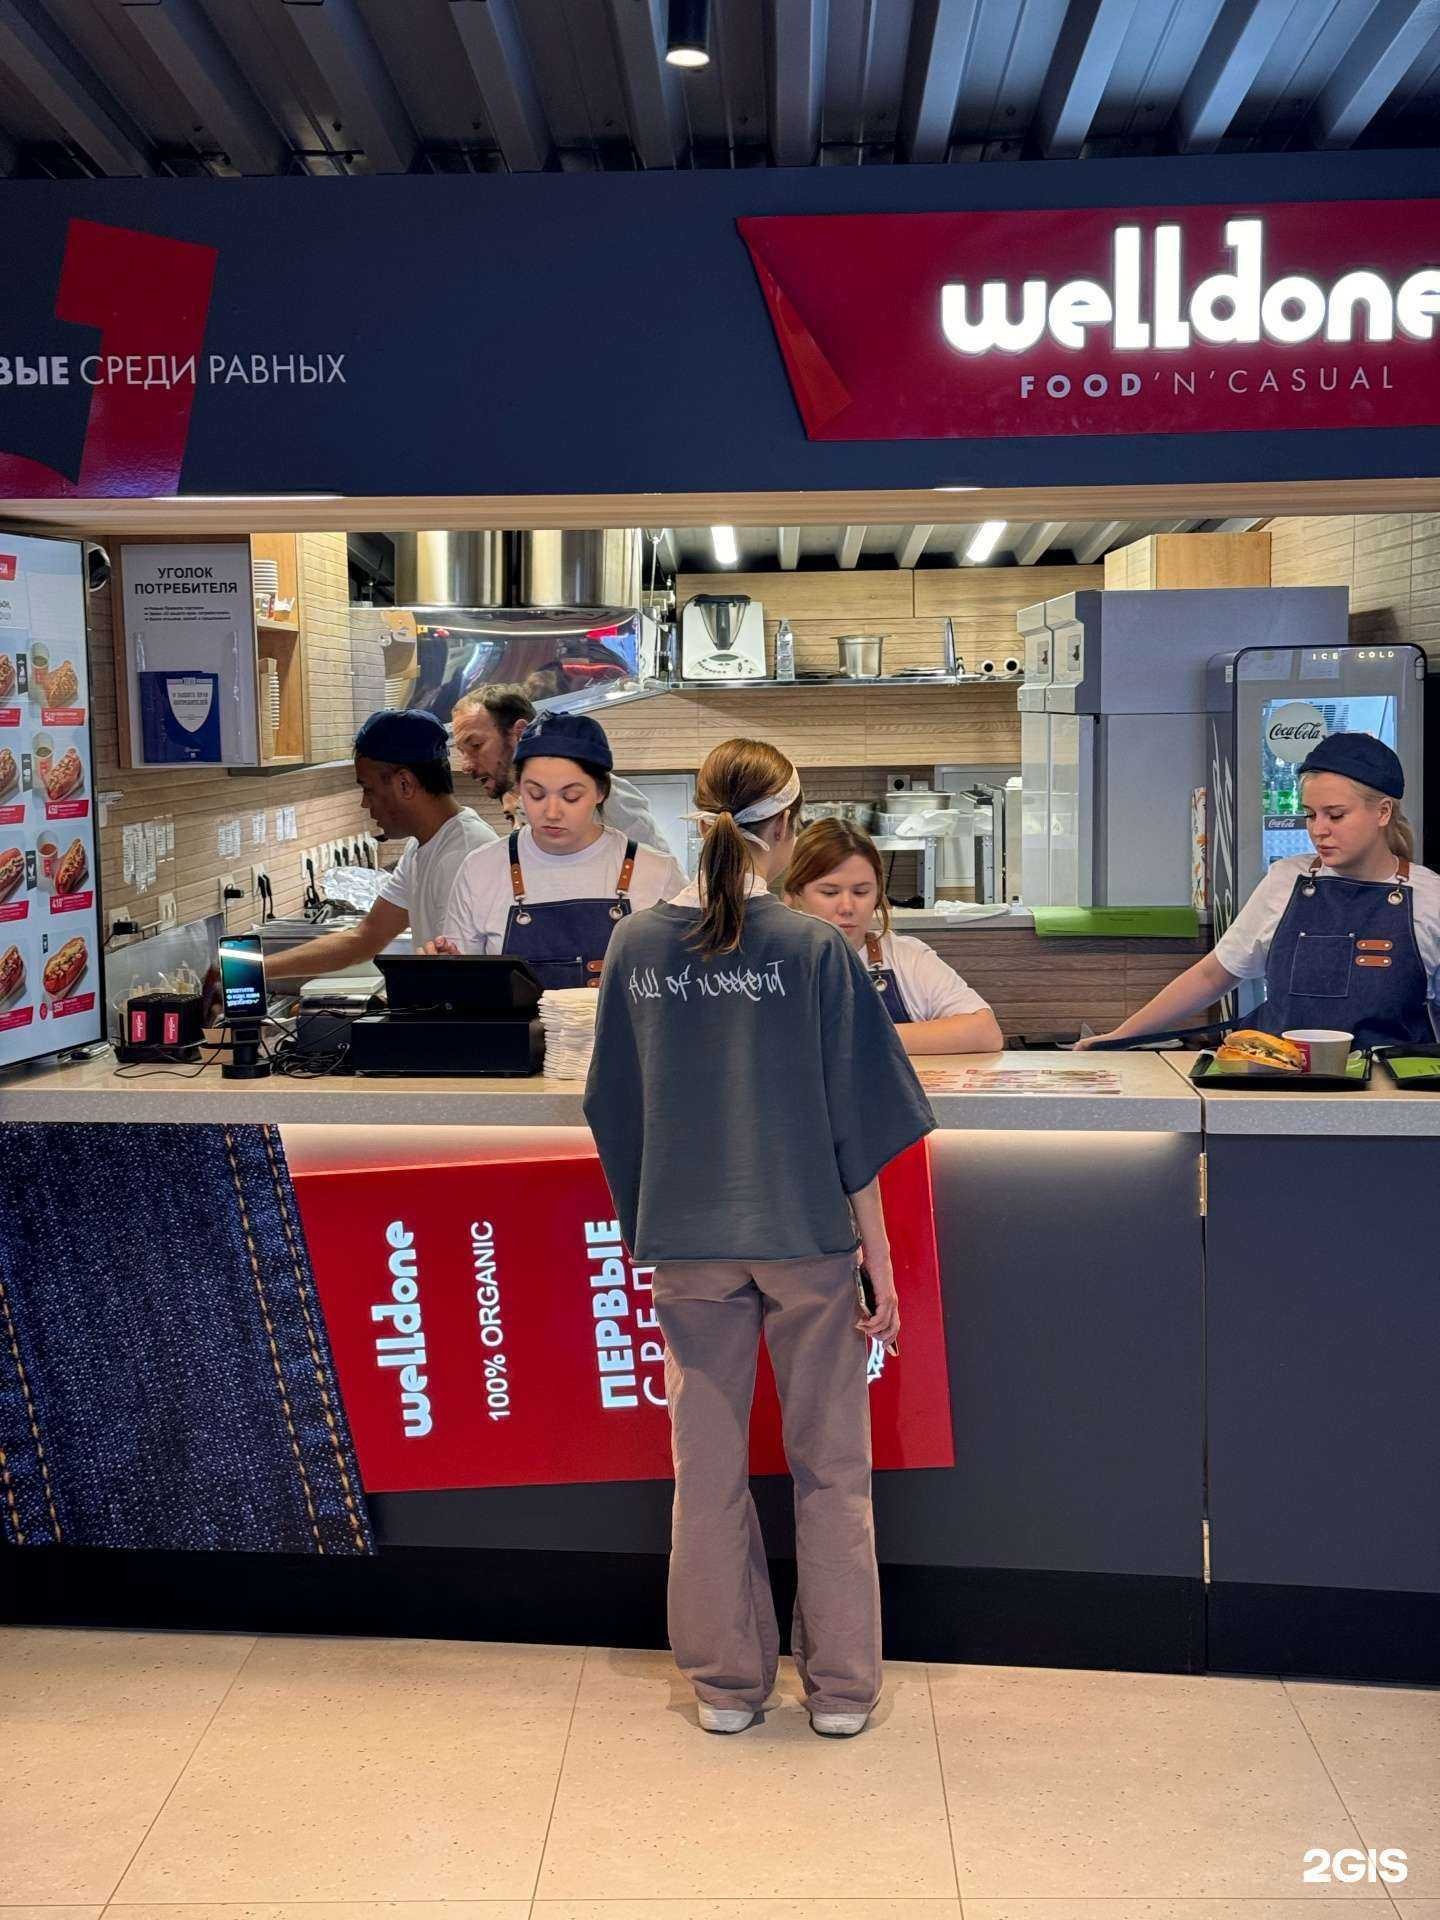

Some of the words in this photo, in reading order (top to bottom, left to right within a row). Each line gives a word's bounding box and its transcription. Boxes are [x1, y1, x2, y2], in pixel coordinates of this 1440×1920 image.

[941, 219, 1440, 354] welldone
[80, 354, 197, 390] СРЕДИ
[209, 353, 347, 385] РАВНЫХ
[134, 582, 238, 595] ПОТРЕБИТЕЛЯ
[157, 567, 214, 580] УГОЛОК
[1312, 652, 1339, 661] ICE
[1358, 650, 1395, 659] COLD
[628, 967, 662, 1004] full
[665, 963, 692, 1002] of
[470, 1220, 504, 1347] ORGANIC
[584, 1219, 639, 1410] ПЕРВЫЕ
[371, 1219, 433, 1438] welldone
[631, 1265, 669, 1407] СРЕД
[483, 1353, 511, 1421] 100%
